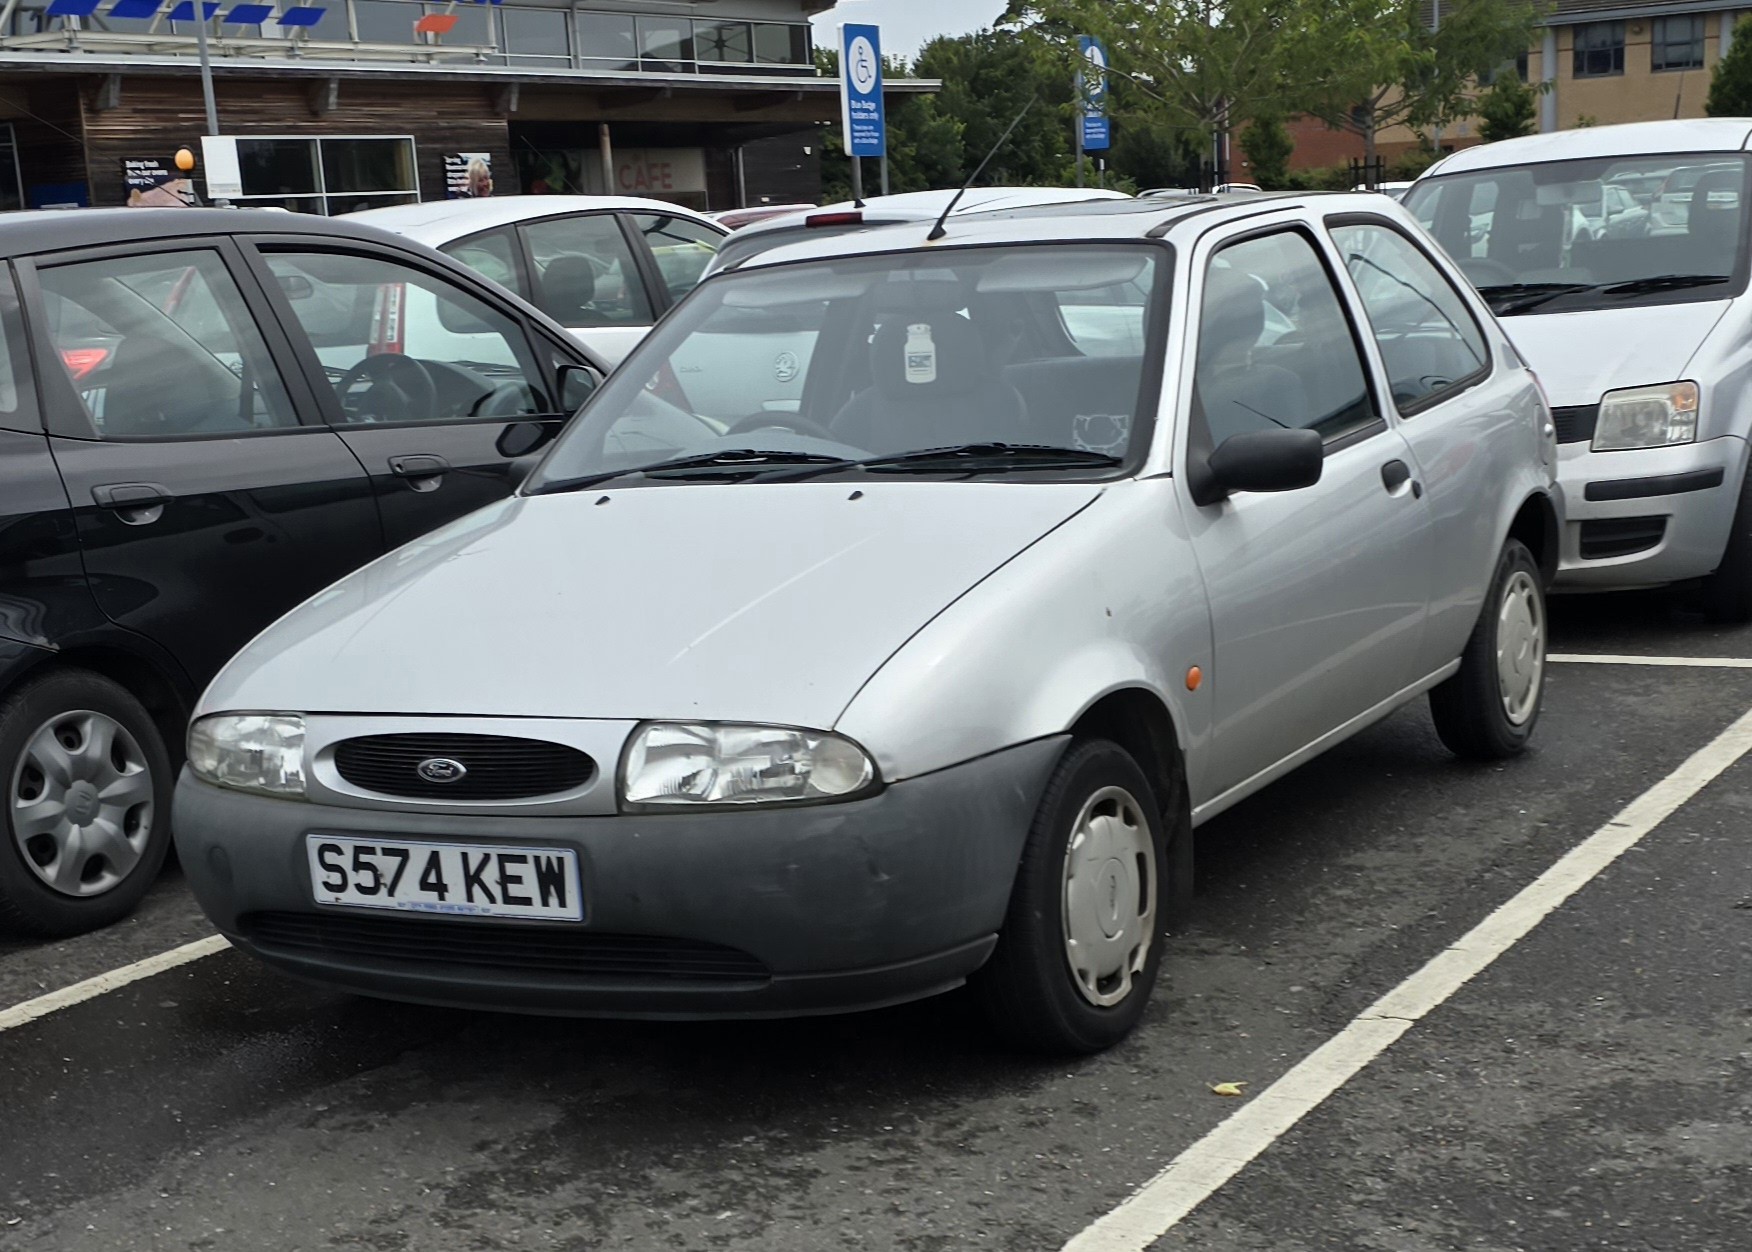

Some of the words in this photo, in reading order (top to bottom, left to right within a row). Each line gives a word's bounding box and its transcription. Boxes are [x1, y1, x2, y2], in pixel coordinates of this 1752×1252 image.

[619, 162, 673, 190] CAFE
[317, 843, 449, 902] S574
[460, 851, 567, 909] KEW
